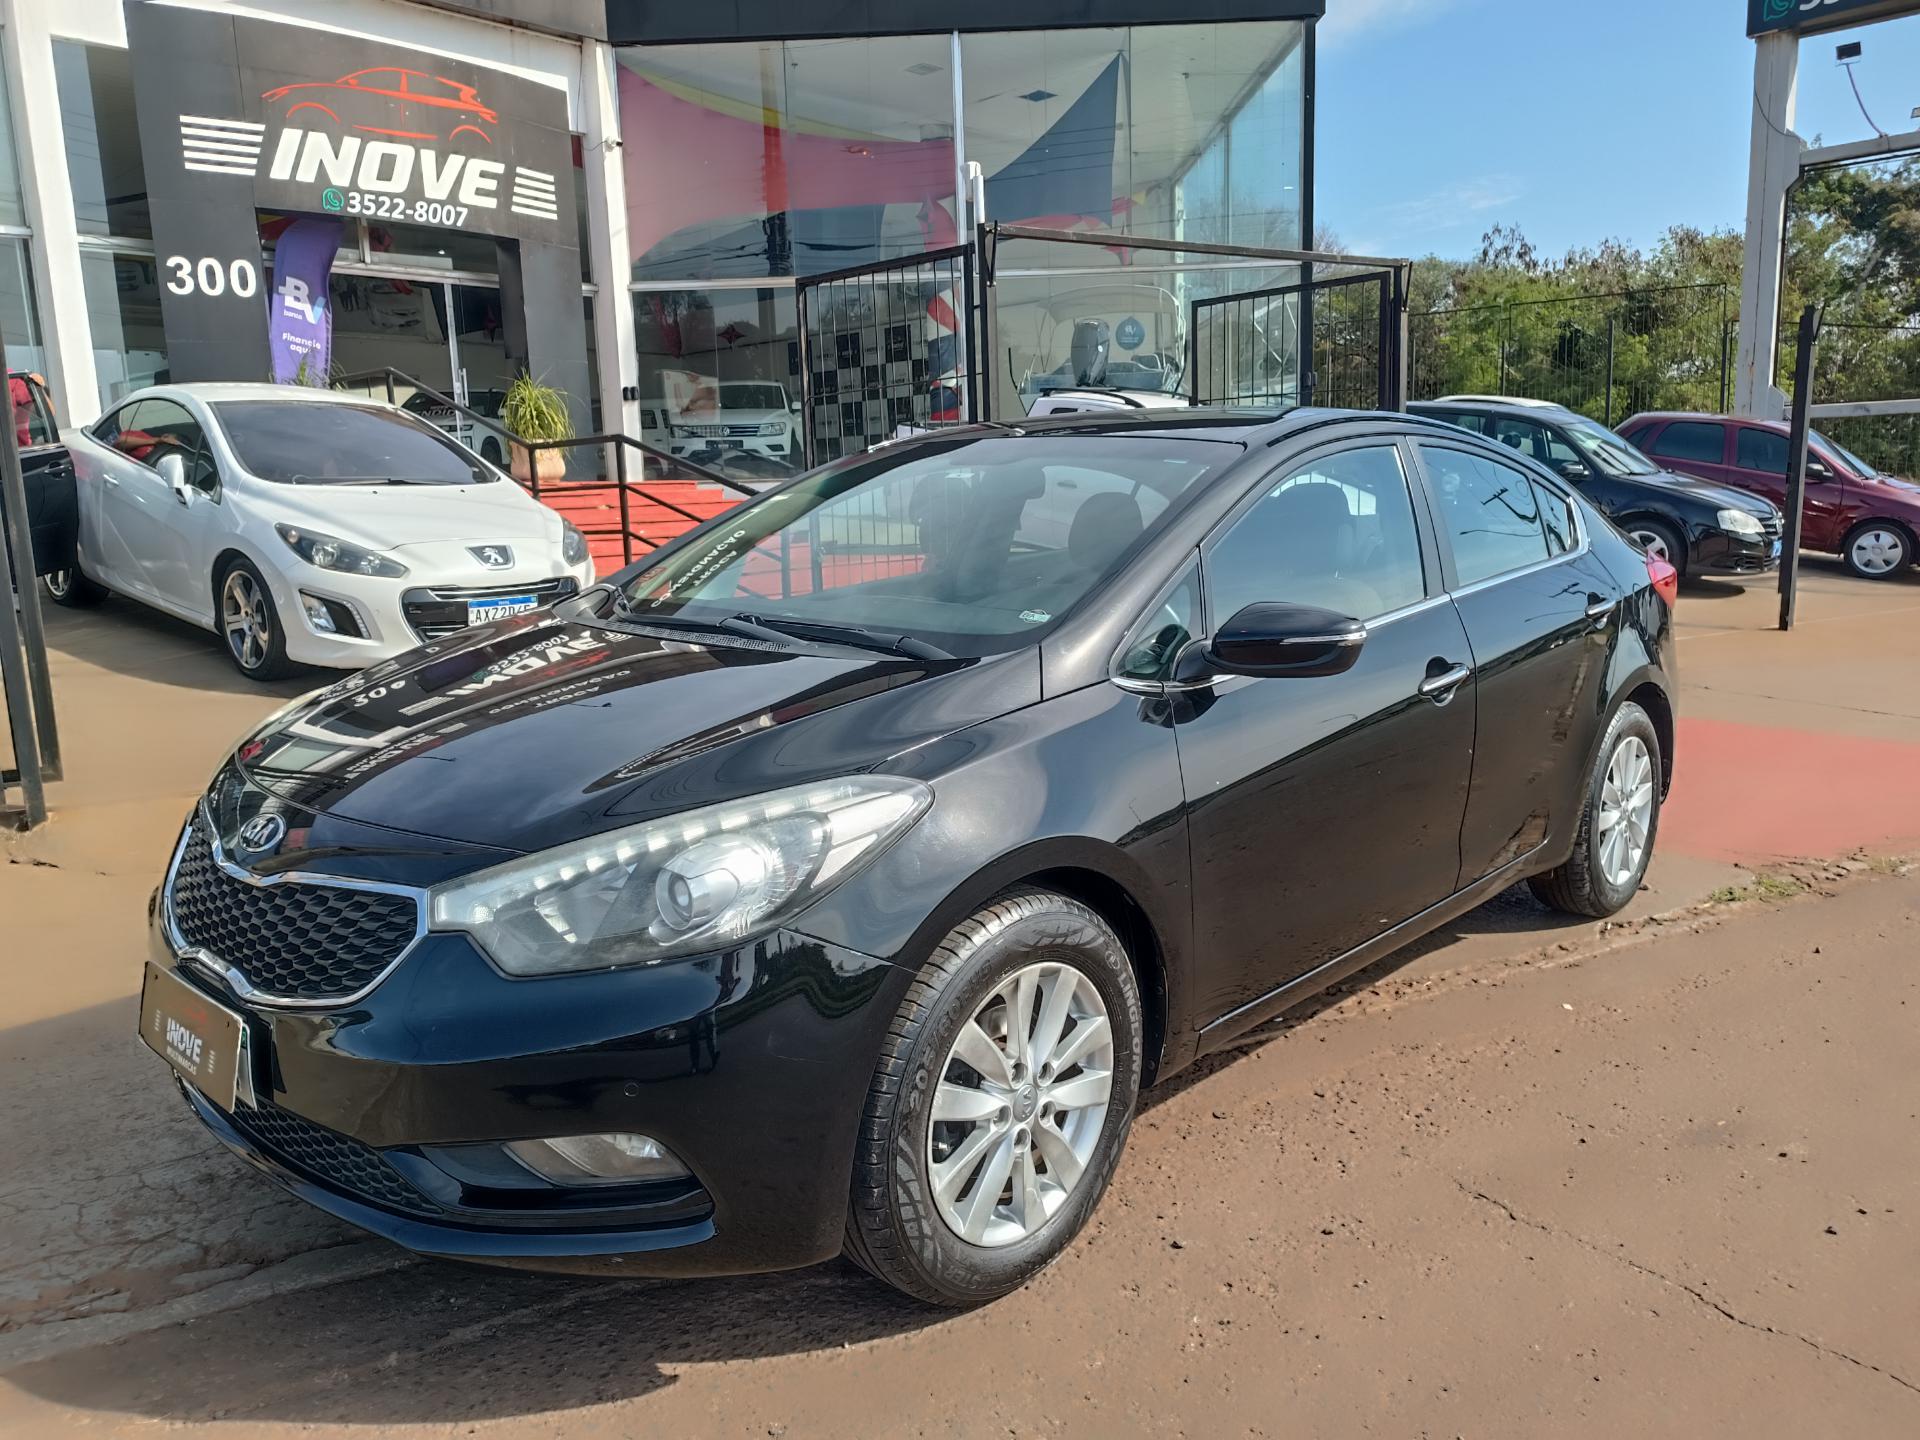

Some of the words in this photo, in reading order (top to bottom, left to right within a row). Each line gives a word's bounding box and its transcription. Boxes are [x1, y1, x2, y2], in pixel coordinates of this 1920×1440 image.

[269, 128, 505, 209] INOVE
[346, 191, 469, 227] 3522-8007
[166, 256, 257, 298] 300
[278, 275, 327, 325] BV
[283, 309, 303, 320] banco
[282, 332, 321, 350] Financie
[475, 604, 531, 623] AXZ2D
[166, 1017, 203, 1065] INOVE
[1117, 971, 1142, 1091] LINGLONG
[166, 1046, 197, 1076] MULTIMARCAS
